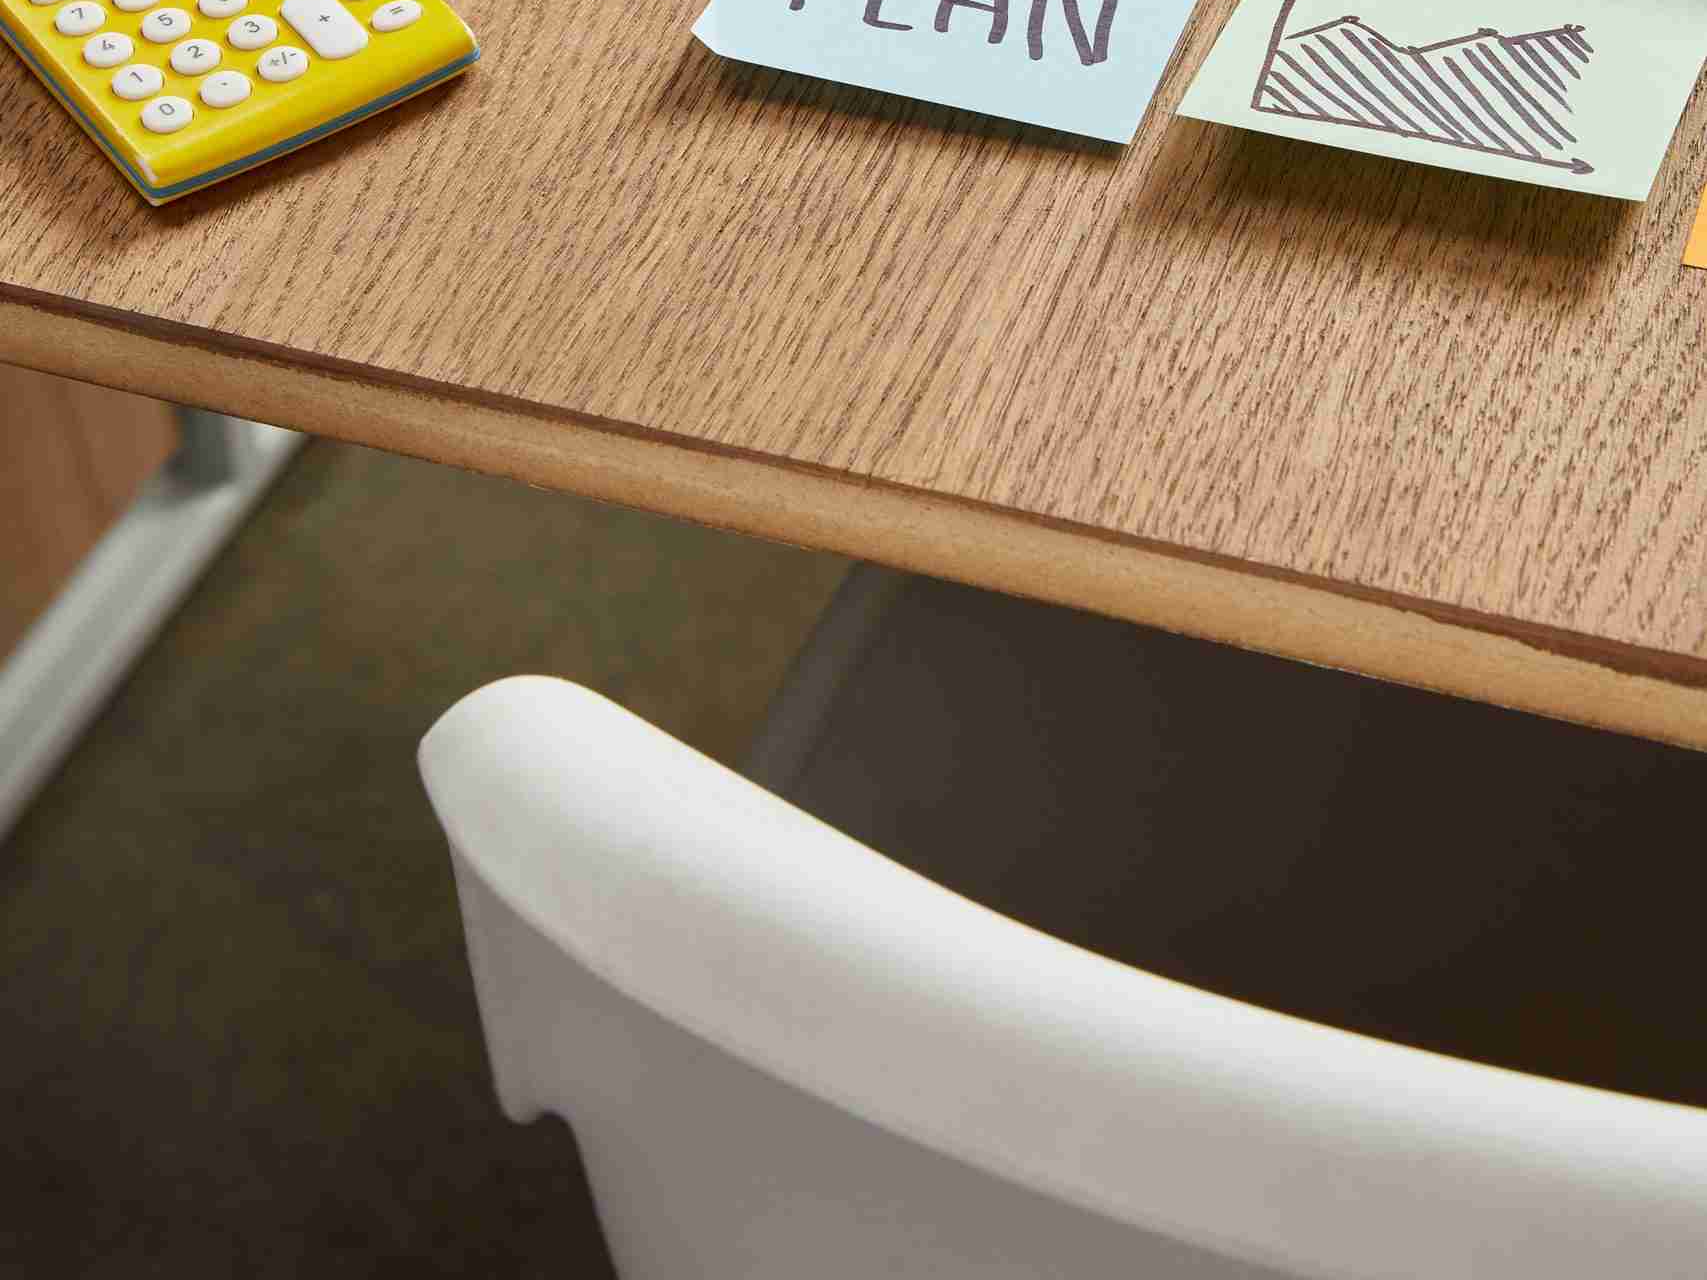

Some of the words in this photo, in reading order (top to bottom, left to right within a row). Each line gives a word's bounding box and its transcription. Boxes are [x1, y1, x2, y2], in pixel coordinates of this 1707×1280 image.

[71, 7, 86, 20] 7
[158, 13, 174, 27] 5
[243, 20, 261, 34] 3
[101, 38, 116, 52] 4
[187, 44, 205, 59] 2
[129, 71, 145, 84] 1
